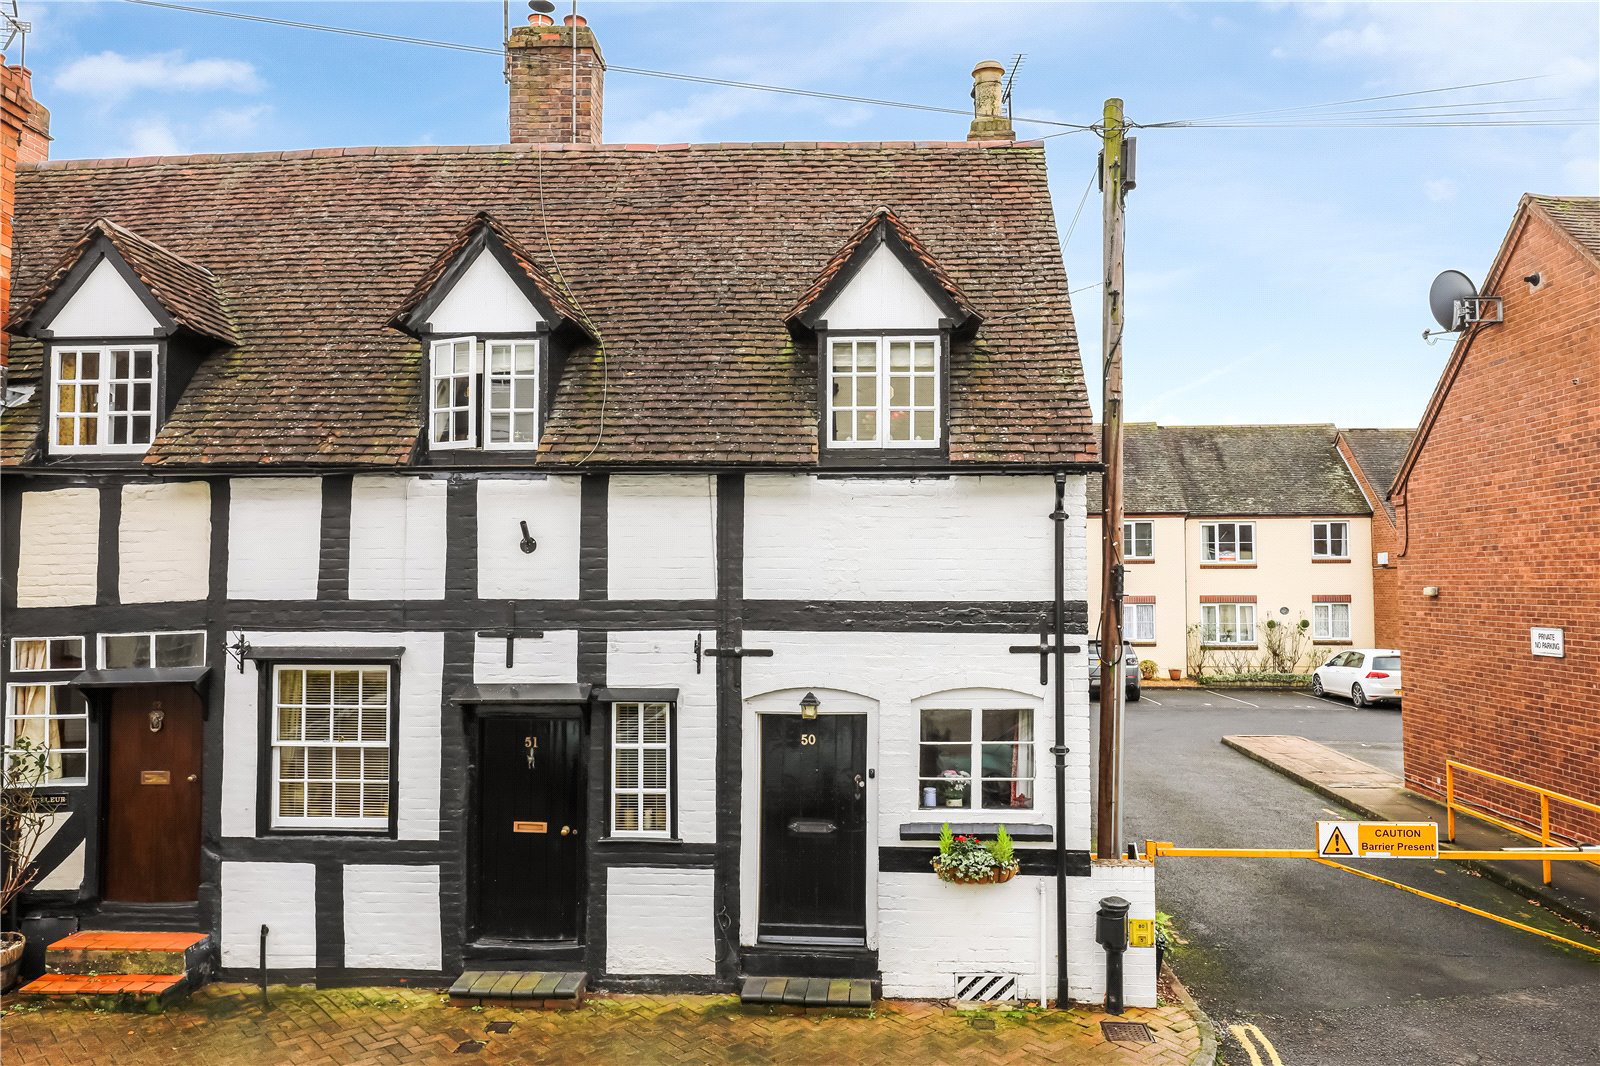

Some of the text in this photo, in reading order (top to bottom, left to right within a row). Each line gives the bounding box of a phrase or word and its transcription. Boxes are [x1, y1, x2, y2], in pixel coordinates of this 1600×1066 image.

[1538, 633, 1555, 641] PRIVATE
[1534, 641, 1560, 650] NO PARKING
[524, 736, 538, 748] 51
[801, 734, 816, 746] 50
[1374, 829, 1421, 838] CAUTION
[1361, 842, 1435, 851] Barrier Present
